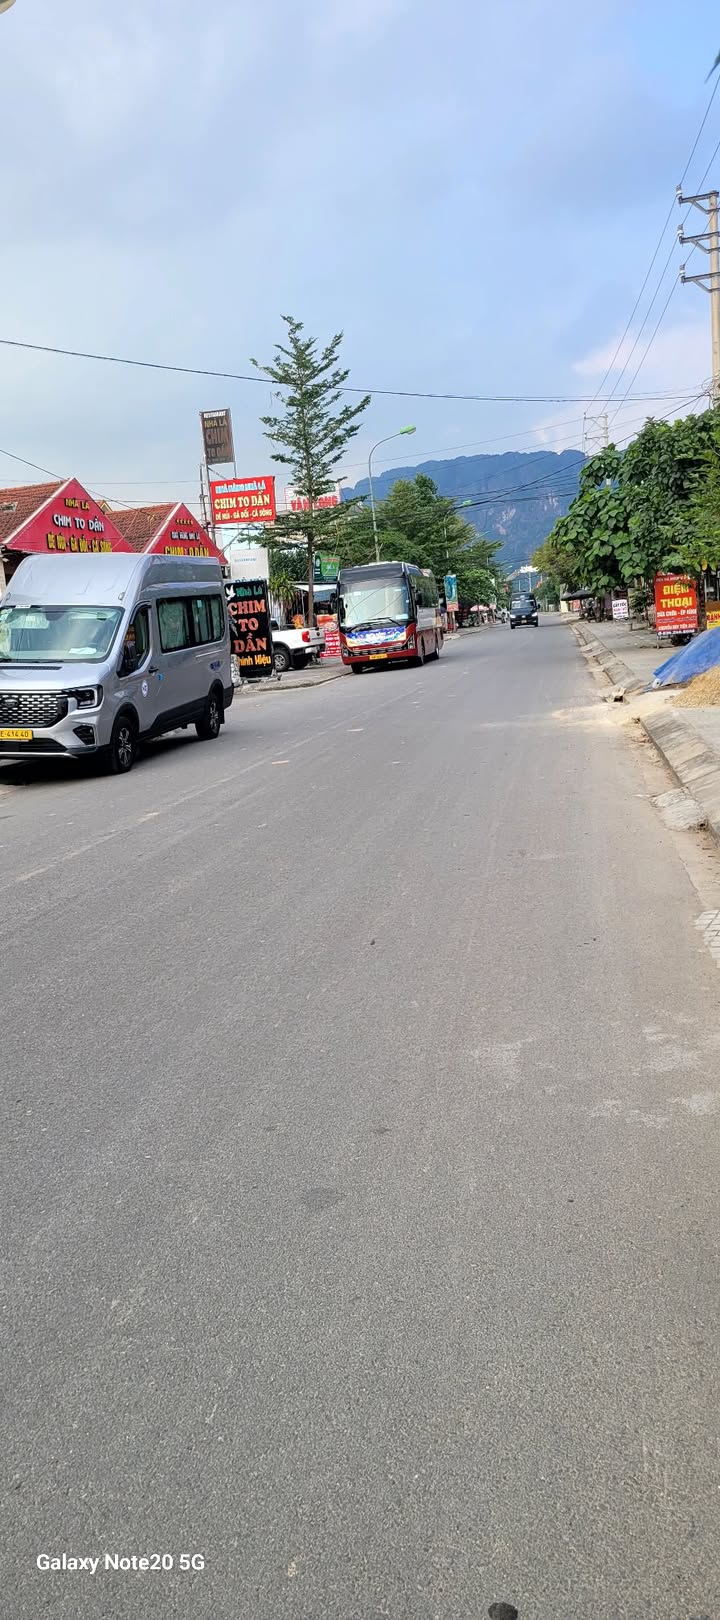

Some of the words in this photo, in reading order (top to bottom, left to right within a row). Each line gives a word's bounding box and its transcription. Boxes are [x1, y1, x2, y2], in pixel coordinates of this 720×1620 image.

[214, 497, 236, 509] CHIM
[237, 496, 249, 508] TO
[53, 513, 72, 528] CHIM
[75, 517, 85, 529] TO
[227, 600, 266, 615] CHIM
[660, 597, 692, 608] THOẠI
[238, 618, 258, 632] TO
